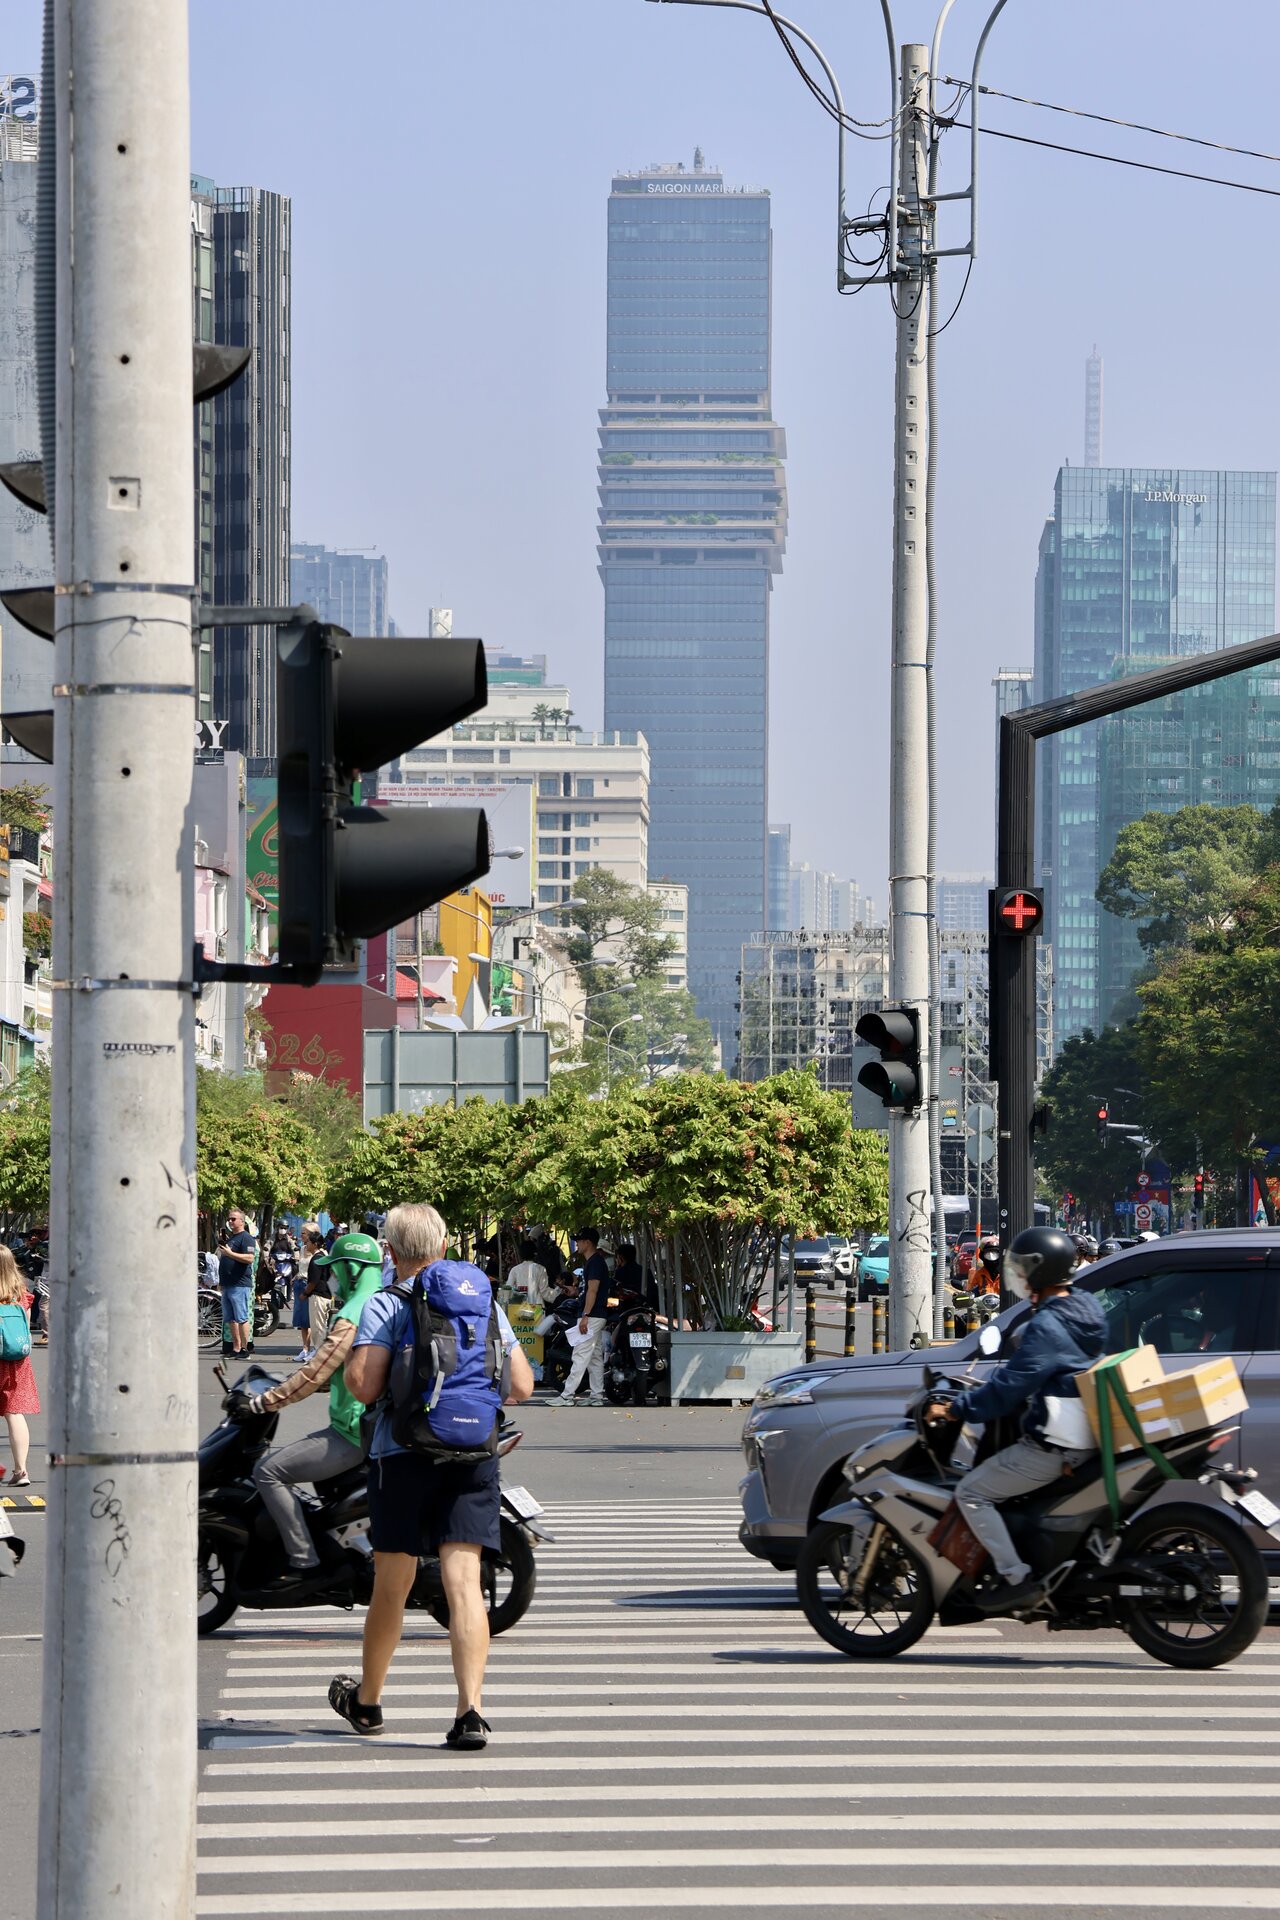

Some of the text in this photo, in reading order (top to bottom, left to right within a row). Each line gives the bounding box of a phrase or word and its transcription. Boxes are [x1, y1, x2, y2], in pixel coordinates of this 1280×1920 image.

[647, 183, 691, 193] SAIGON
[1144, 491, 1207, 506] J.P.Morgan
[488, 892, 505, 903] ÚC
[344, 1242, 371, 1253] Grab
